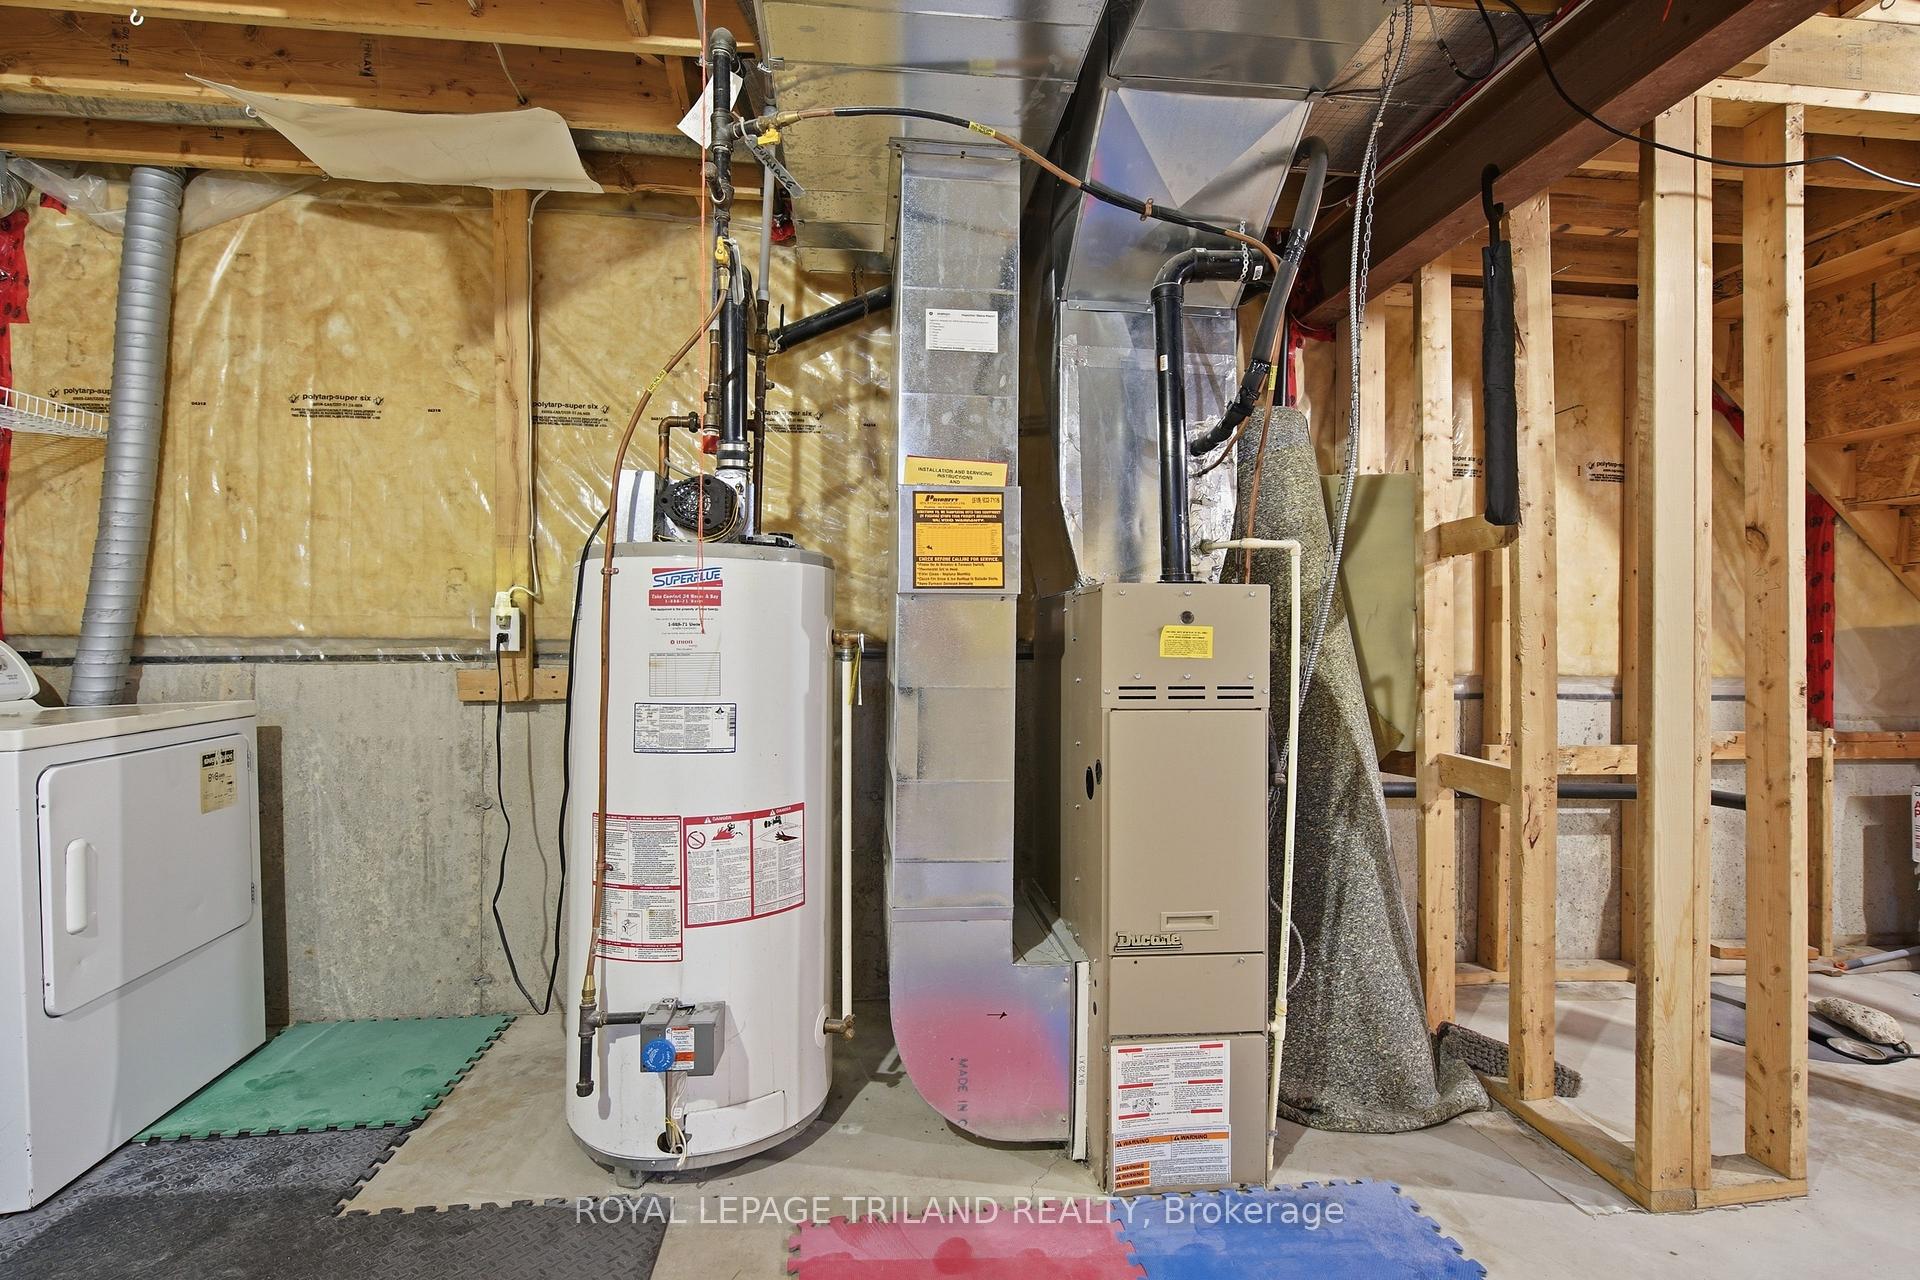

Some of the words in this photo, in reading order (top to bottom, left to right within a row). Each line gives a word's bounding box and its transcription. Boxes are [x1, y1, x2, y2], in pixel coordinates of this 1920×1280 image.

[302, 394, 357, 402] polytarp-super
[532, 401, 586, 410] polytarp-super
[653, 570, 720, 588] SUPERFLUE
[957, 1058, 968, 1092] MADE
[957, 1100, 968, 1112] IN
[1123, 1138, 1150, 1146] WARNING
